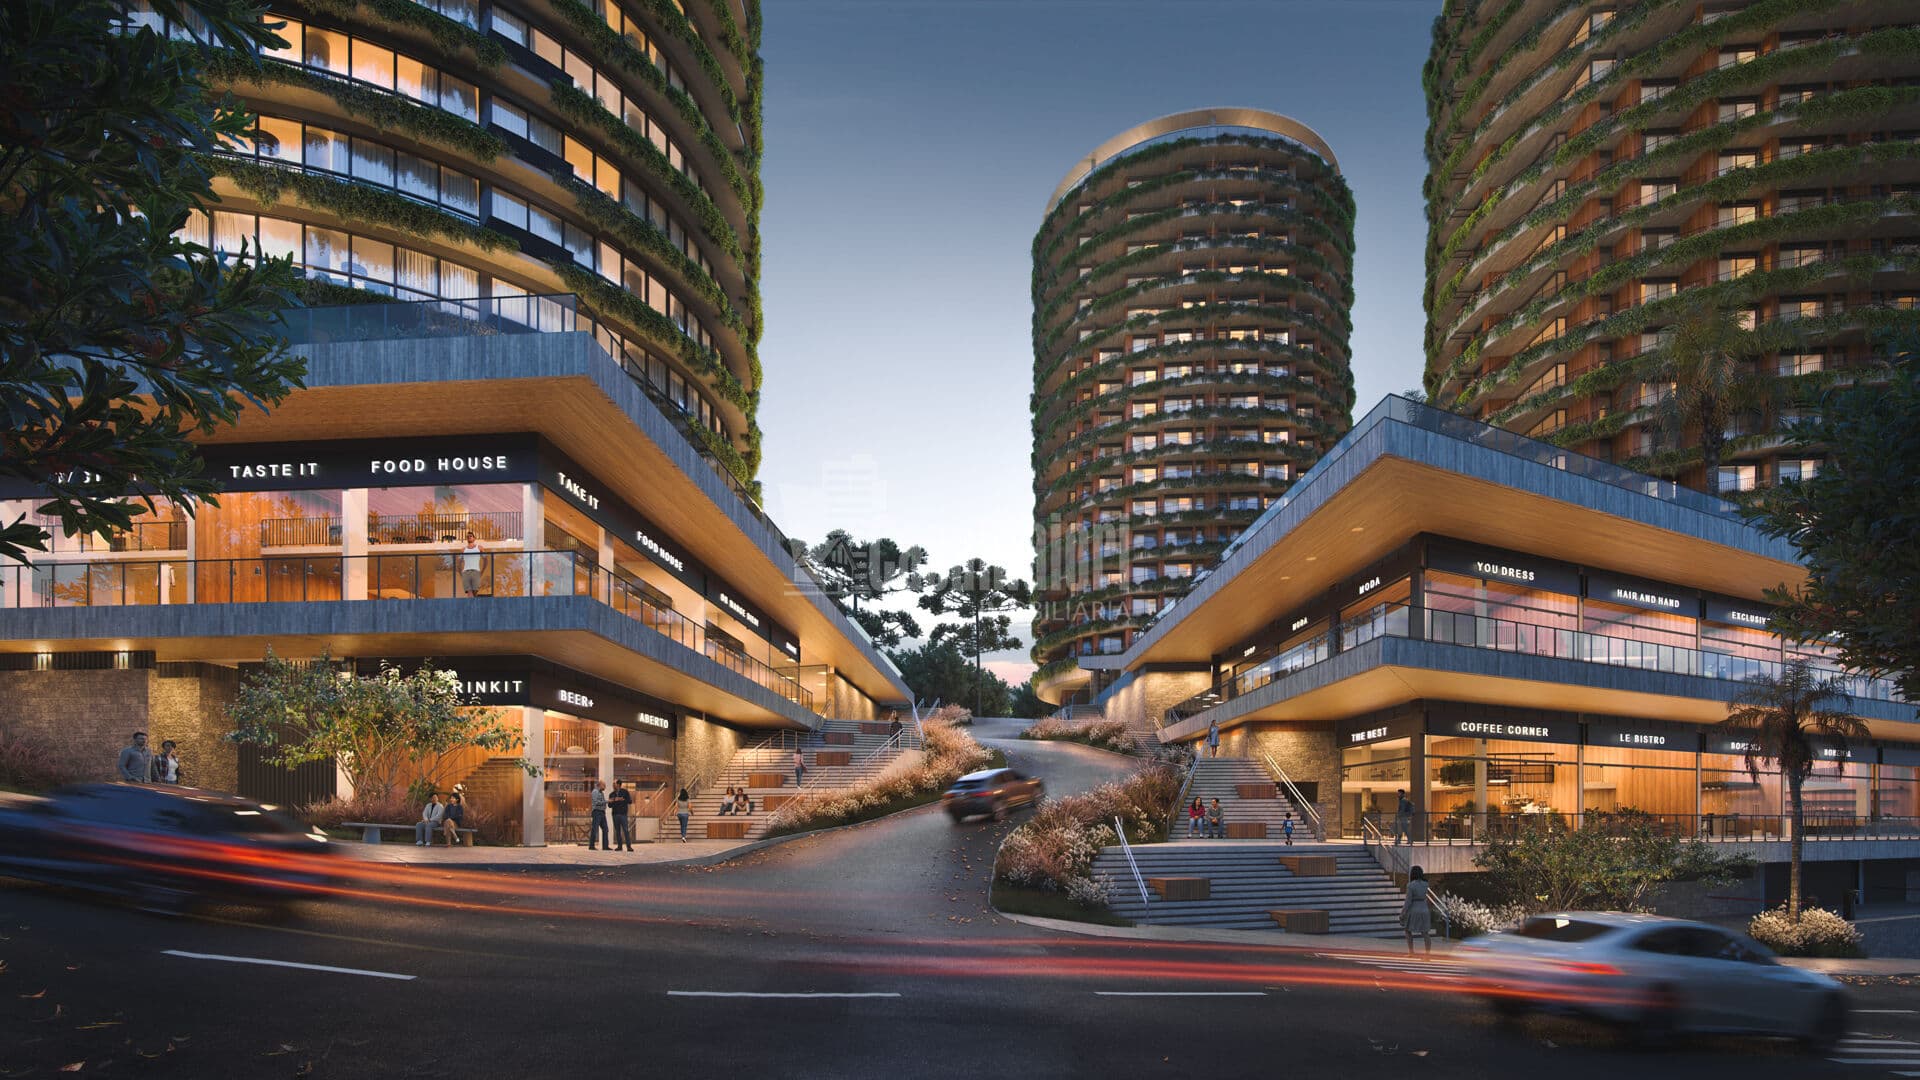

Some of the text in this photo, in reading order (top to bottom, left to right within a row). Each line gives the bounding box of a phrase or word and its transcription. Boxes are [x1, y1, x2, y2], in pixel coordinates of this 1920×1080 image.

[229, 461, 318, 478] TASTE IT
[370, 455, 507, 474] FOOD HOUSE
[558, 471, 600, 511] TAKE IT
[636, 529, 685, 572] FOOD HOUSE
[1476, 560, 1535, 581] YOU DRESS
[1359, 576, 1380, 595] MODA
[1616, 588, 1680, 608] HAIR AND HAND
[1731, 610, 1771, 625] EXCLUSIV
[452, 680, 523, 694] RINKIT
[559, 689, 594, 708] BEER+
[639, 712, 669, 729] ABERTO
[1460, 721, 1549, 737] COFFEE CORNER
[1351, 726, 1388, 743] THE BEST
[1619, 732, 1666, 745] LE BISTRO
